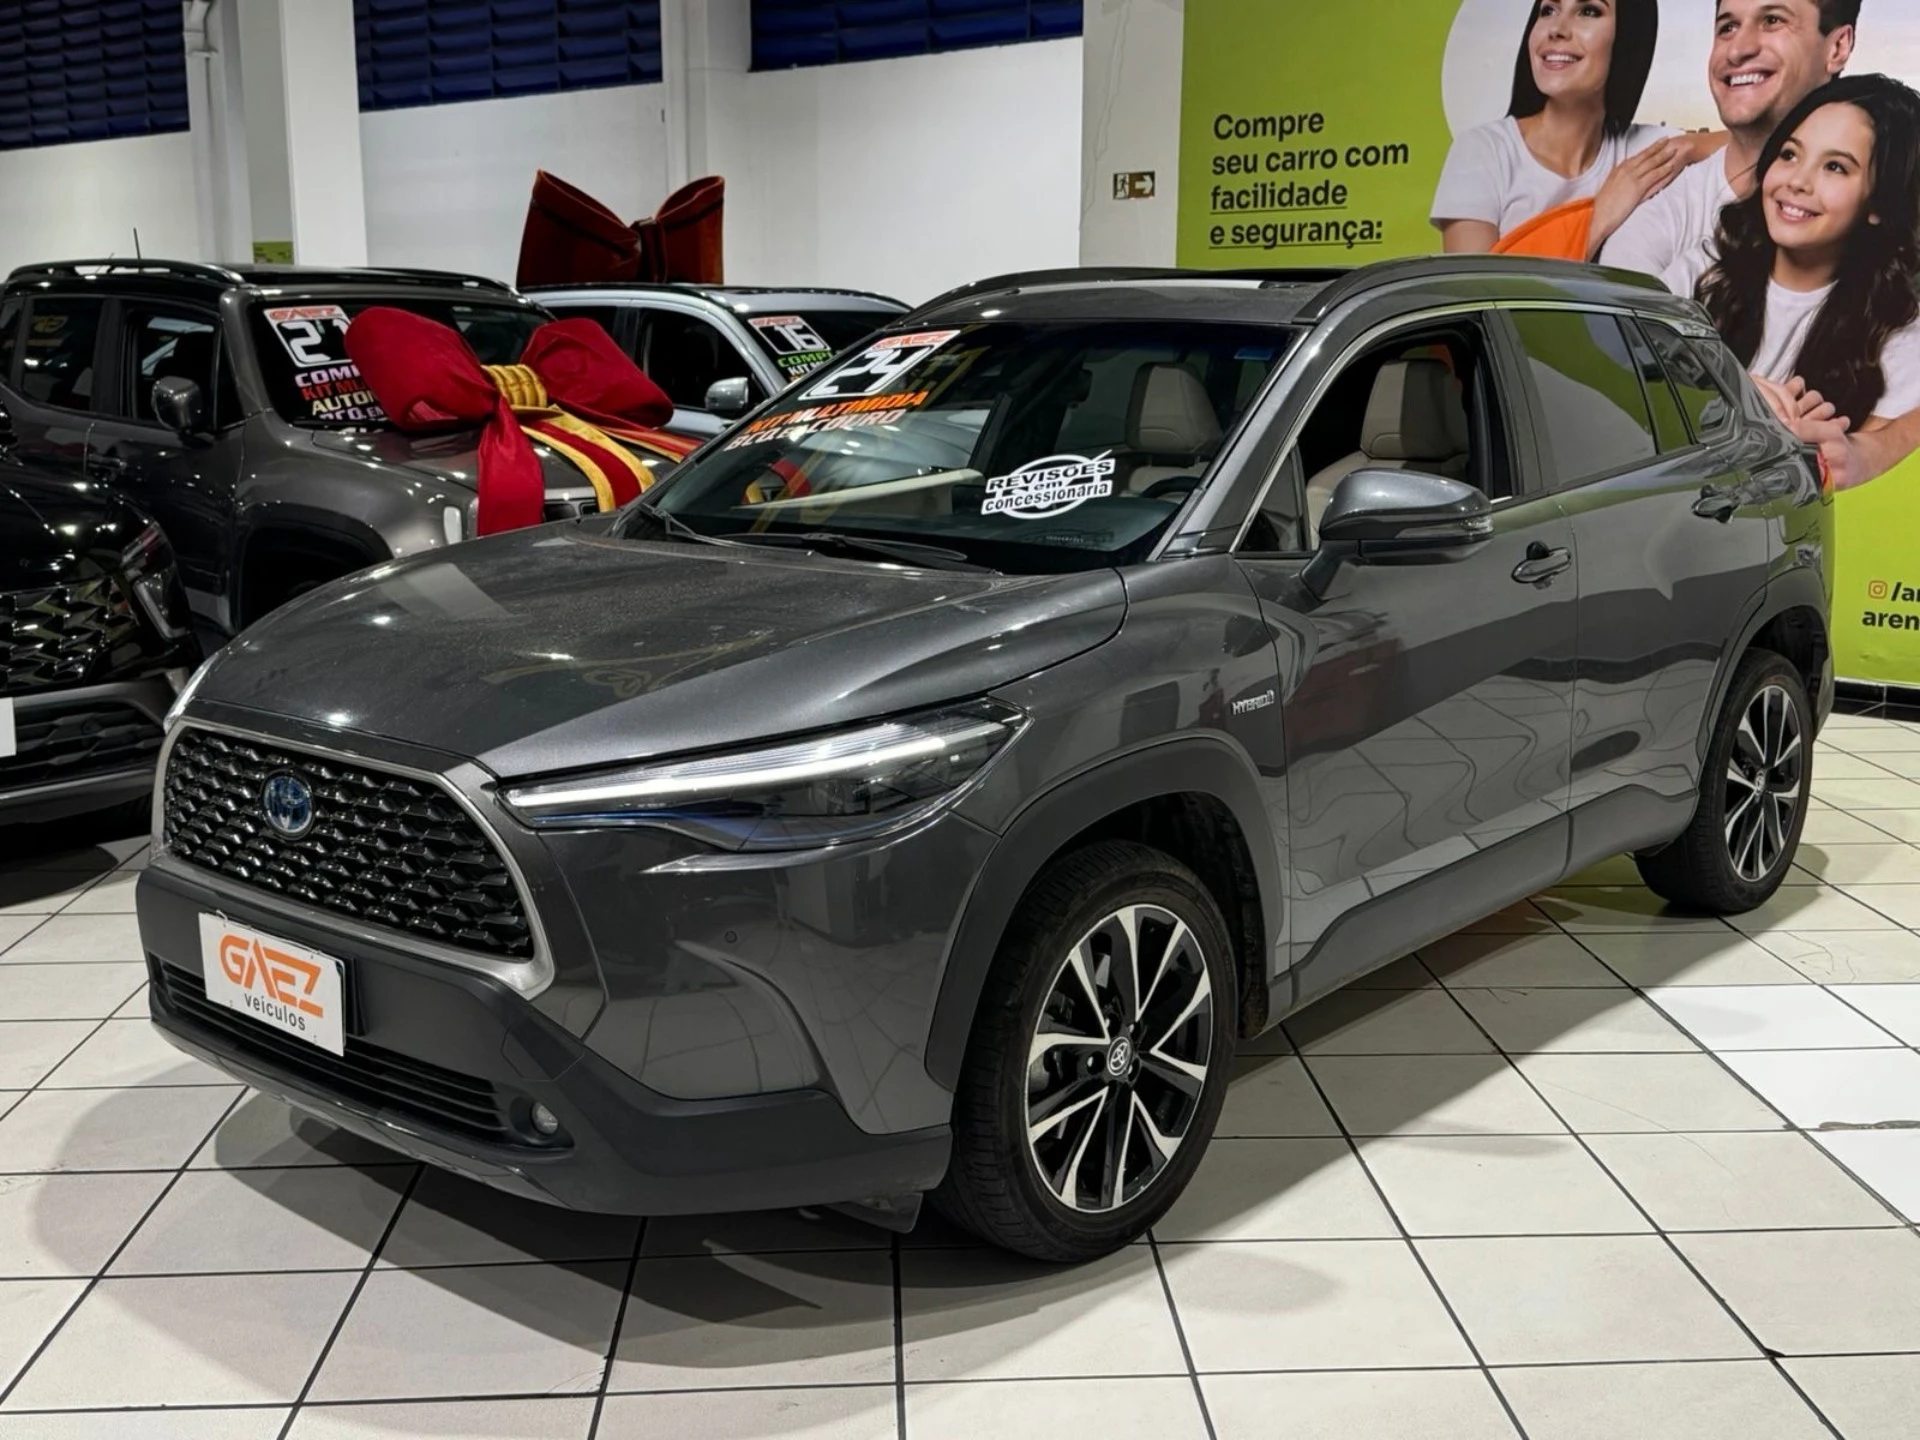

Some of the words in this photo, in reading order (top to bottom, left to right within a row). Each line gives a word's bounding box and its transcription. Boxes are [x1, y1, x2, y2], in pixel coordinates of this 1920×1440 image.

[1213, 112, 1324, 142] Compre
[1211, 151, 1258, 176] seu
[1265, 146, 1338, 172] carro
[1344, 142, 1409, 168] com
[1210, 180, 1348, 211] facilidade
[1209, 224, 1225, 245] e
[1231, 218, 1383, 250] segurança:
[773, 324, 826, 351] 16
[808, 346, 932, 396] 24
[988, 461, 1111, 490] REVISÕES
[1033, 480, 1063, 491] em
